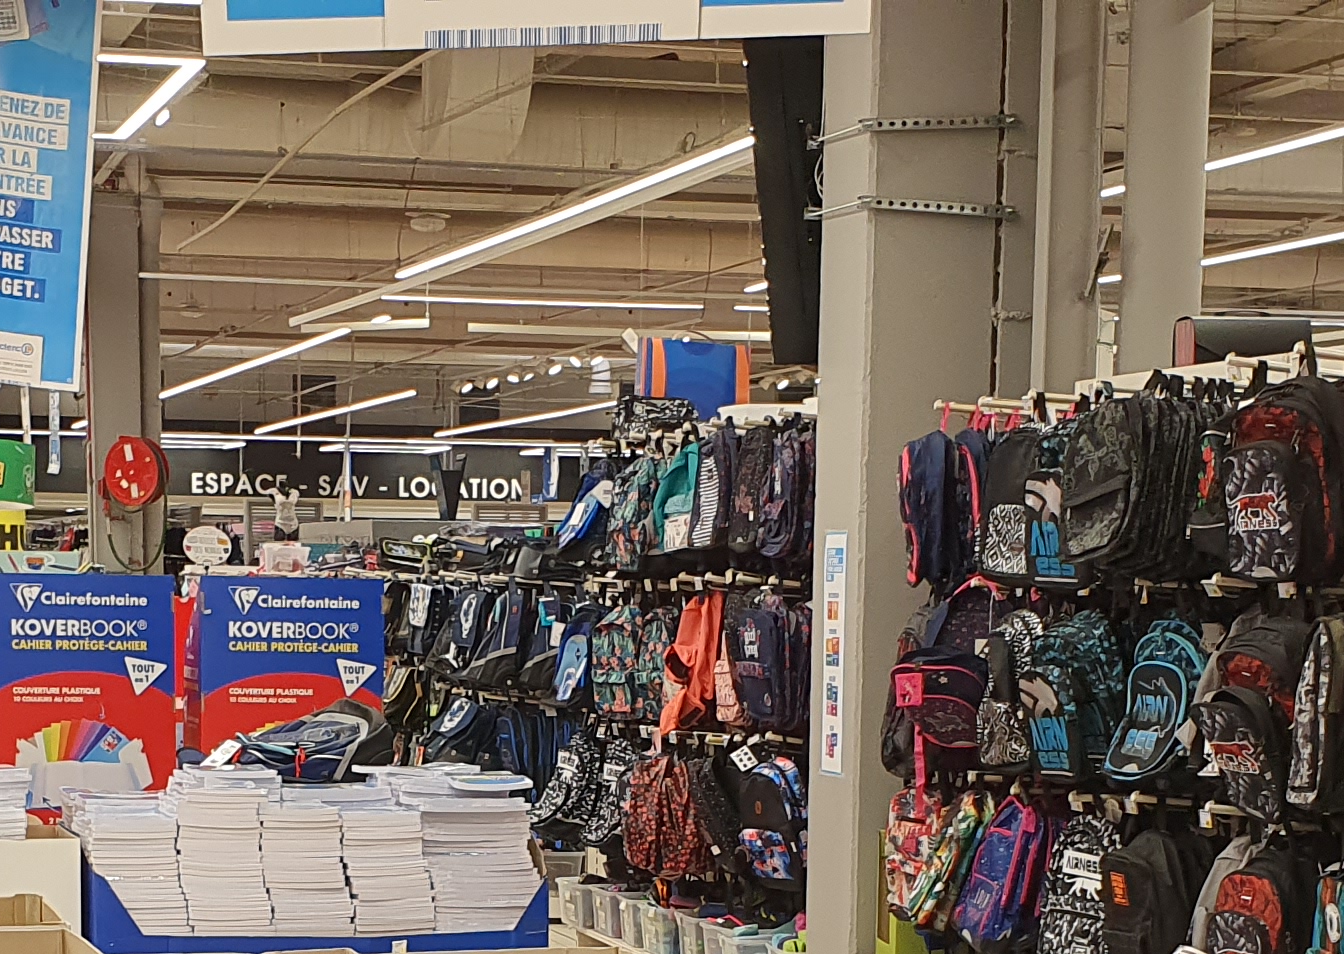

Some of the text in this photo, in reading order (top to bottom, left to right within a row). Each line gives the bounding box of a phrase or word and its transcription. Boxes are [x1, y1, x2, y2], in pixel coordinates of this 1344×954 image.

[43, 101, 66, 119] DE
[12, 149, 32, 168] LA
[191, 472, 288, 495] ESPACE
[40, 592, 148, 607] Clairefontaine
[257, 595, 360, 610] Clairefontaine
[11, 637, 148, 651] CAHIER PROTÈGE-CAHIER
[228, 639, 359, 653] CAHIER PROTÈGE-CAHIER
[131, 664, 156, 674] TOUT
[342, 665, 365, 675] TOUT
[12, 686, 101, 695] COUVERTURE PLASTIQUE
[228, 687, 314, 697] COUVERTURE PLASTIQUE
